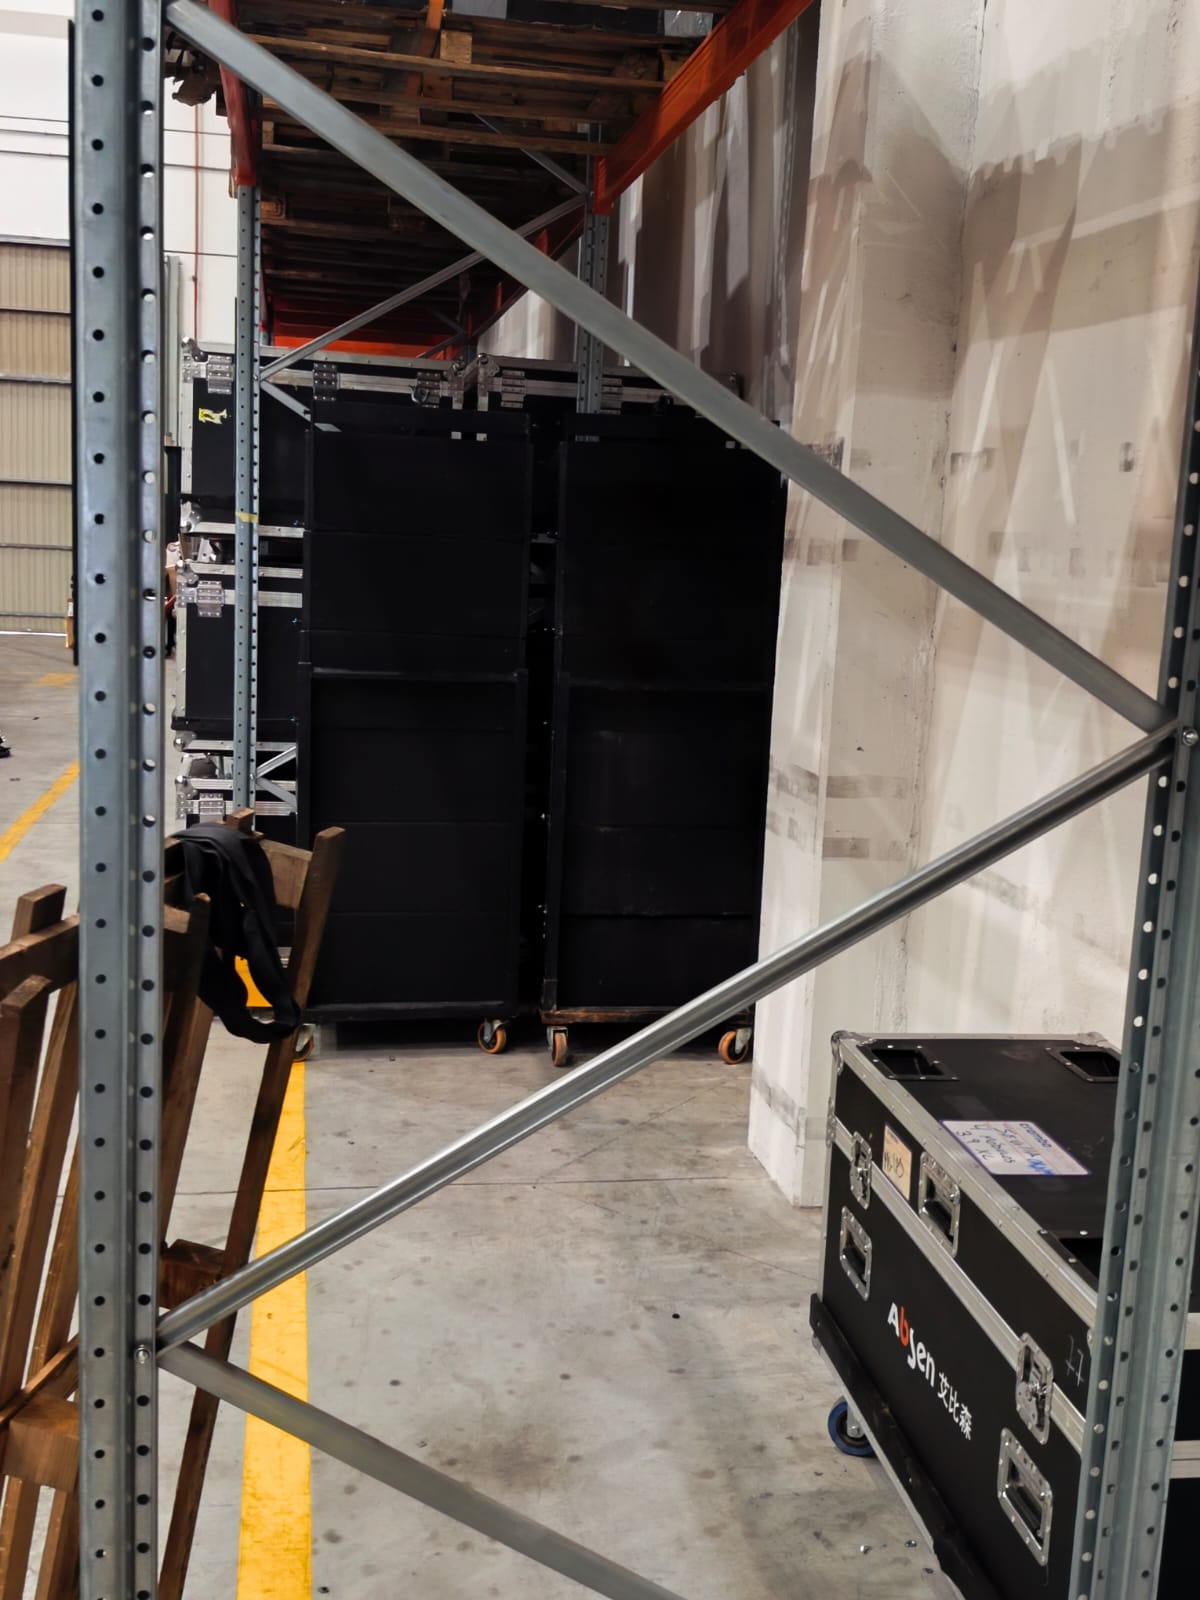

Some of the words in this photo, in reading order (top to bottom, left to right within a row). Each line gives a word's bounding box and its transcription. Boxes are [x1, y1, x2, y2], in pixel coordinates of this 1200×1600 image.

[887, 1302, 936, 1388] Absen
[937, 1371, 972, 1440] 艾比森
